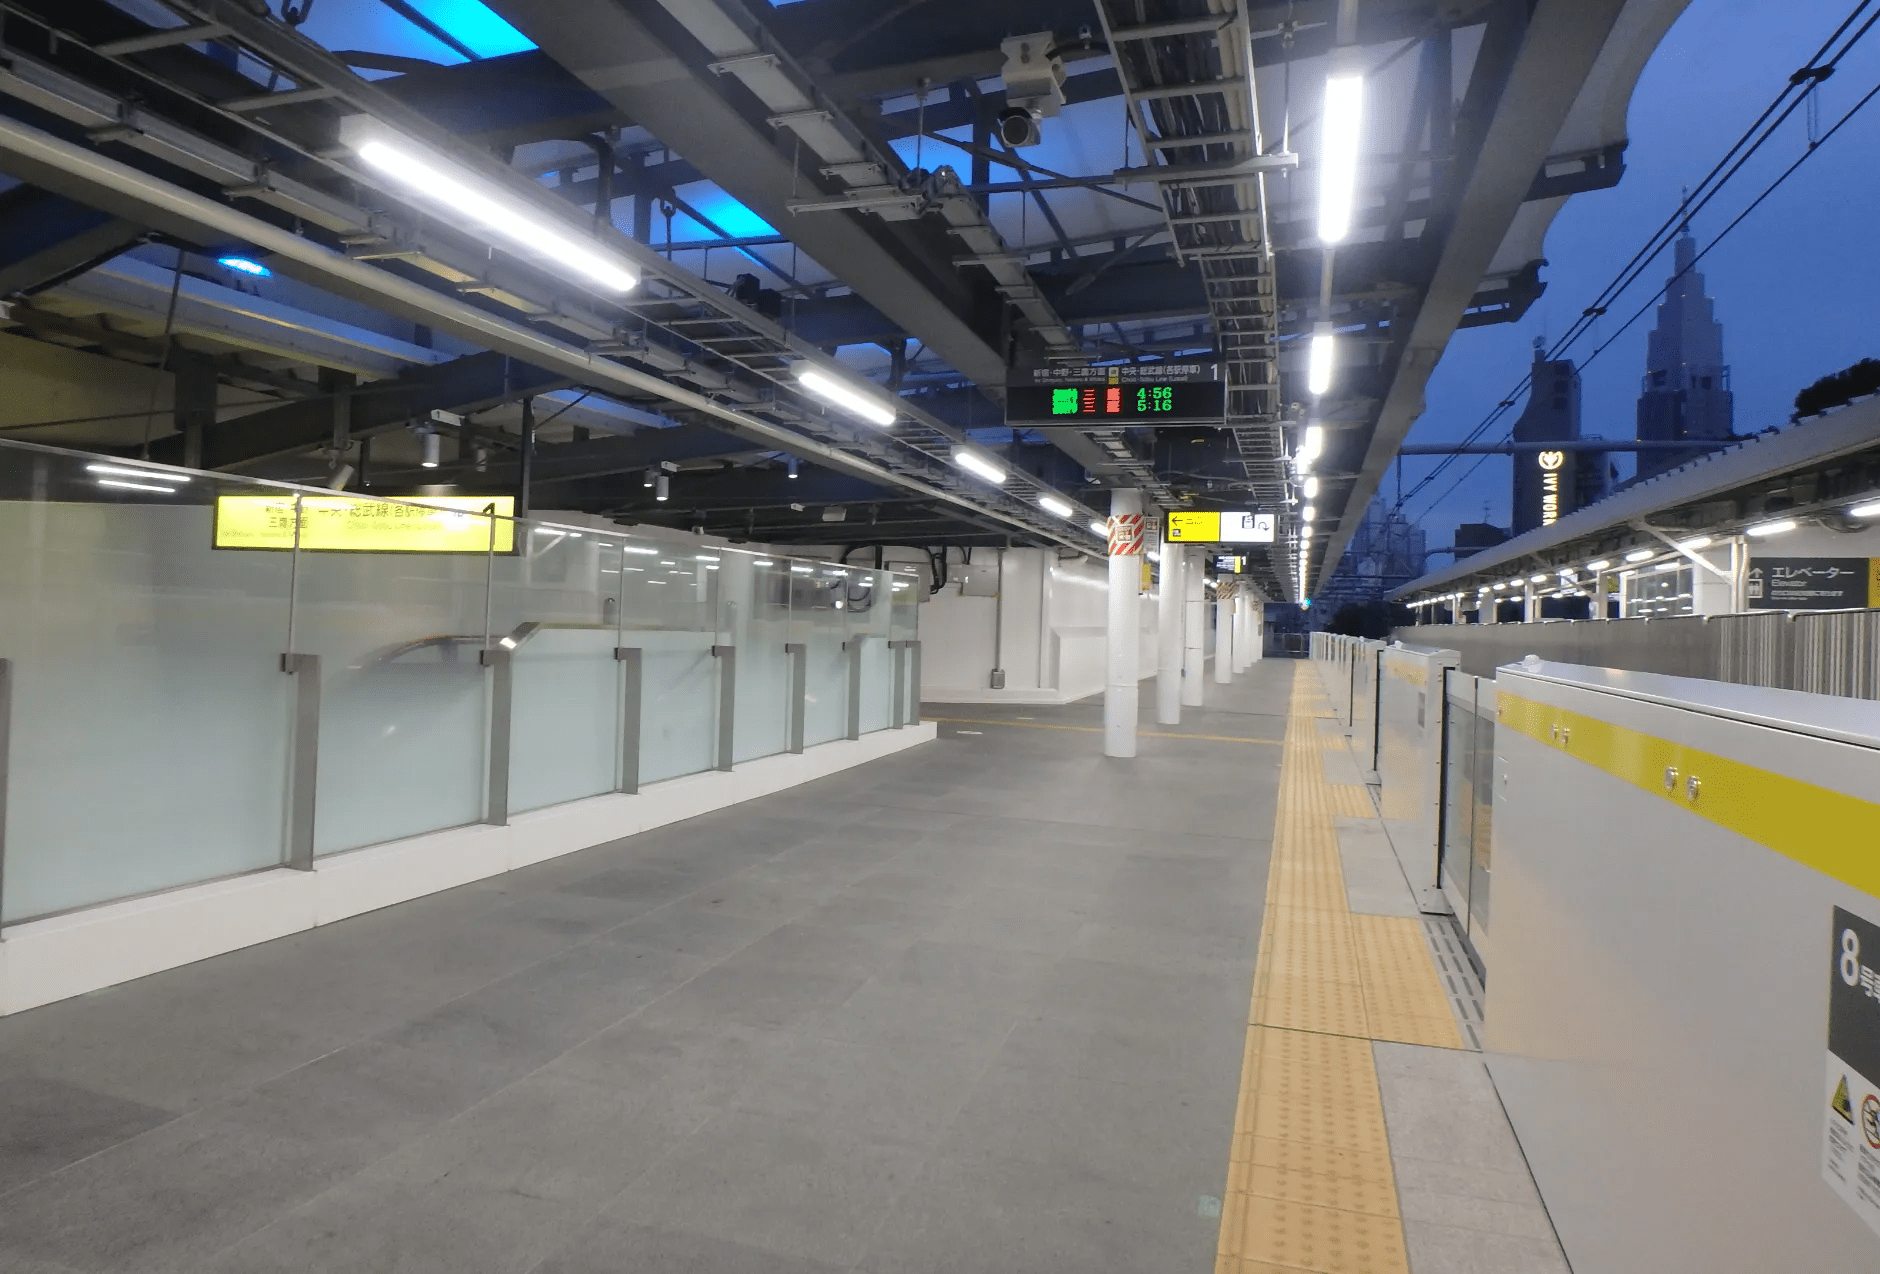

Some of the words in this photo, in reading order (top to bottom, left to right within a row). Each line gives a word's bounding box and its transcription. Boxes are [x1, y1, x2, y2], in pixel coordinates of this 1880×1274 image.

[1210, 363, 1218, 380] 1
[1136, 387, 1173, 399] 4:56
[1136, 399, 1173, 412] 5:16
[1542, 472, 1558, 492] IVY
[1771, 566, 1855, 579] エレベーター
